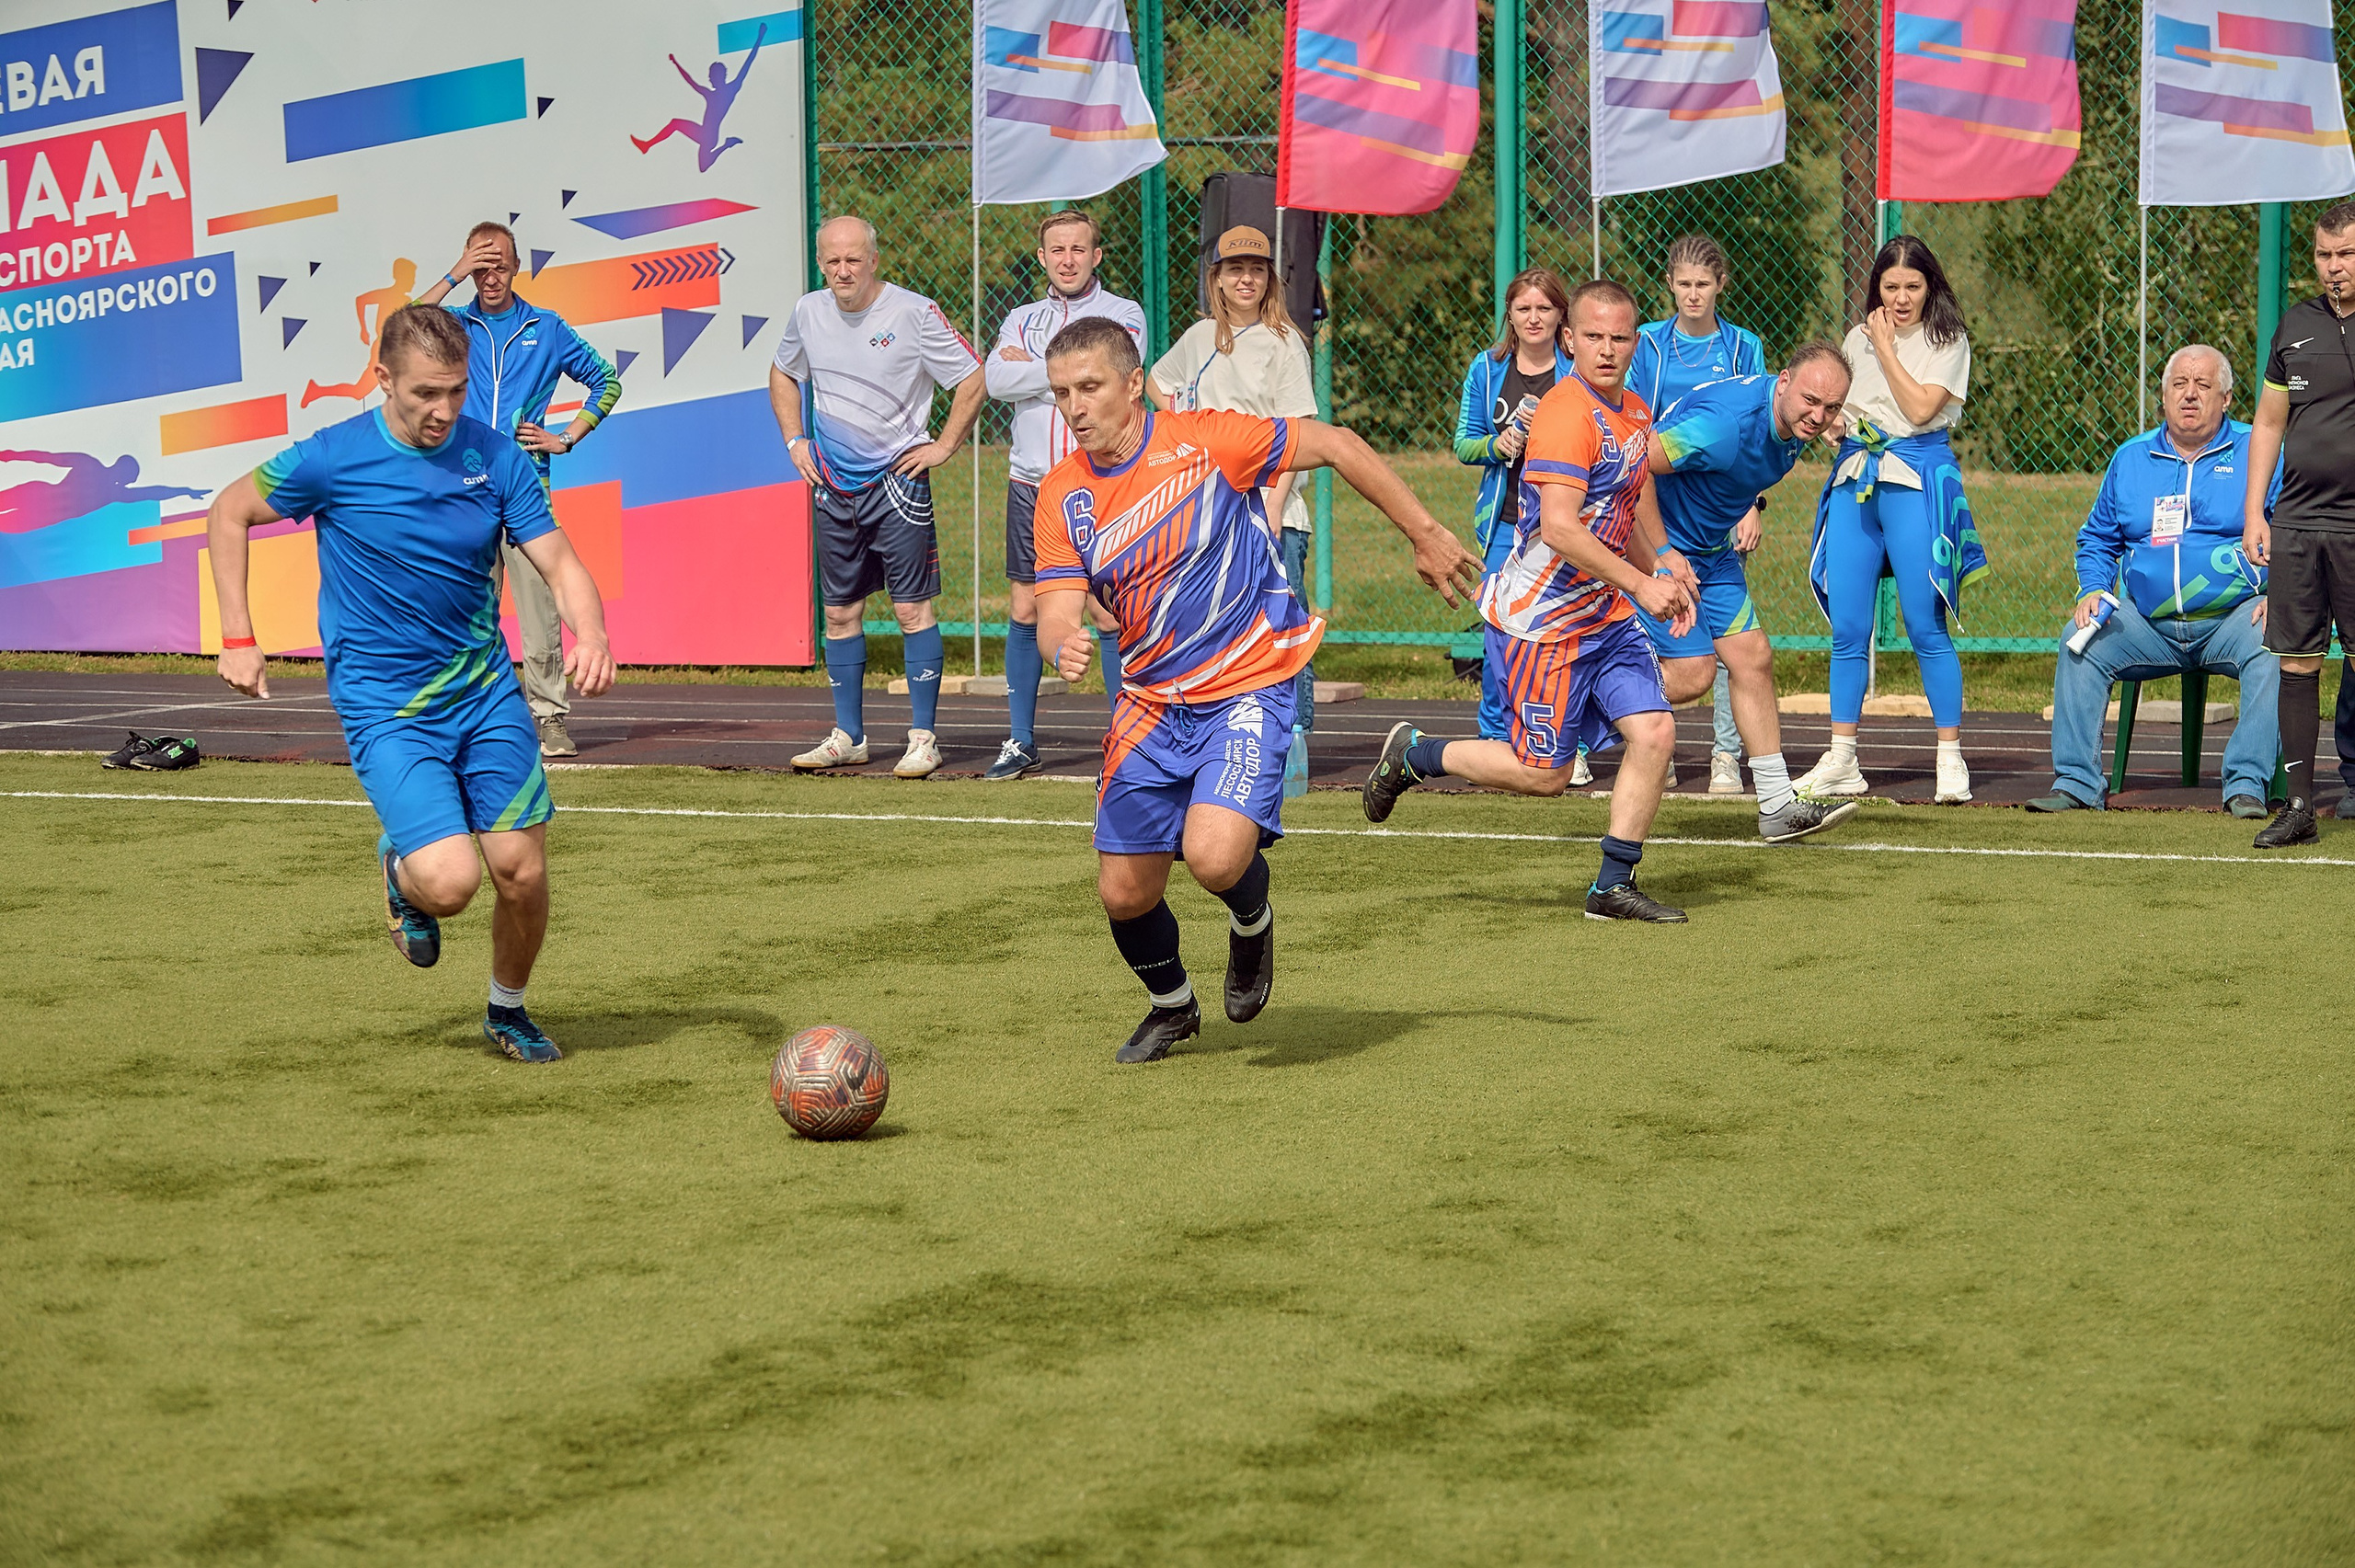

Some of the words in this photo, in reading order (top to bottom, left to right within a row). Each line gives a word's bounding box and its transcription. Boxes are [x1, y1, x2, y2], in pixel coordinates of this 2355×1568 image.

[0, 45, 106, 114] ВАЯ
[0, 230, 136, 286] СПОРТА
[0, 268, 216, 334] АСНОЯРСКОГО
[1148, 454, 1178, 467] АВТОДОР
[1592, 406, 1624, 463] 5
[1062, 486, 1097, 556] 6
[1521, 702, 1558, 758] 5
[1233, 737, 1262, 807] АВТОДОР
